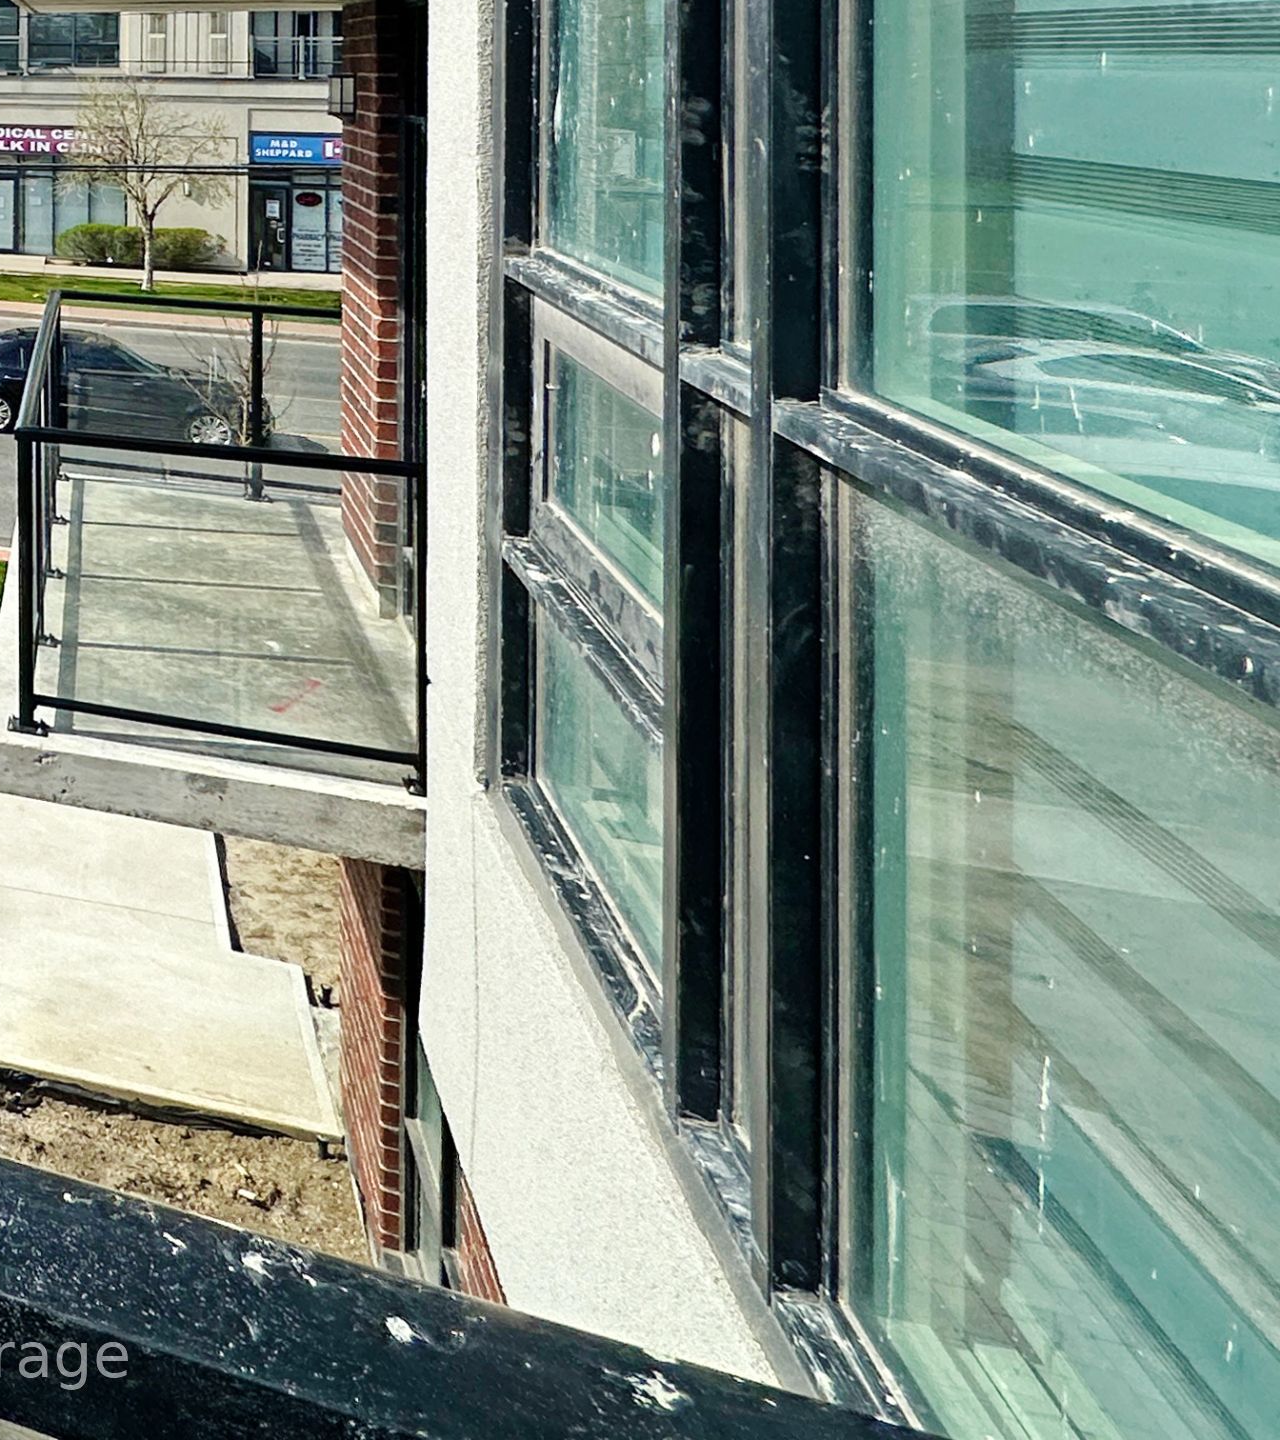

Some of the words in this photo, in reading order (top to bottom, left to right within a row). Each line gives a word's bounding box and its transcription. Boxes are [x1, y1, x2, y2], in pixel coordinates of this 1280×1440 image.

[29, 141, 50, 153] IN
[269, 139, 298, 149] M&D
[255, 148, 314, 158] SHEPPARD
